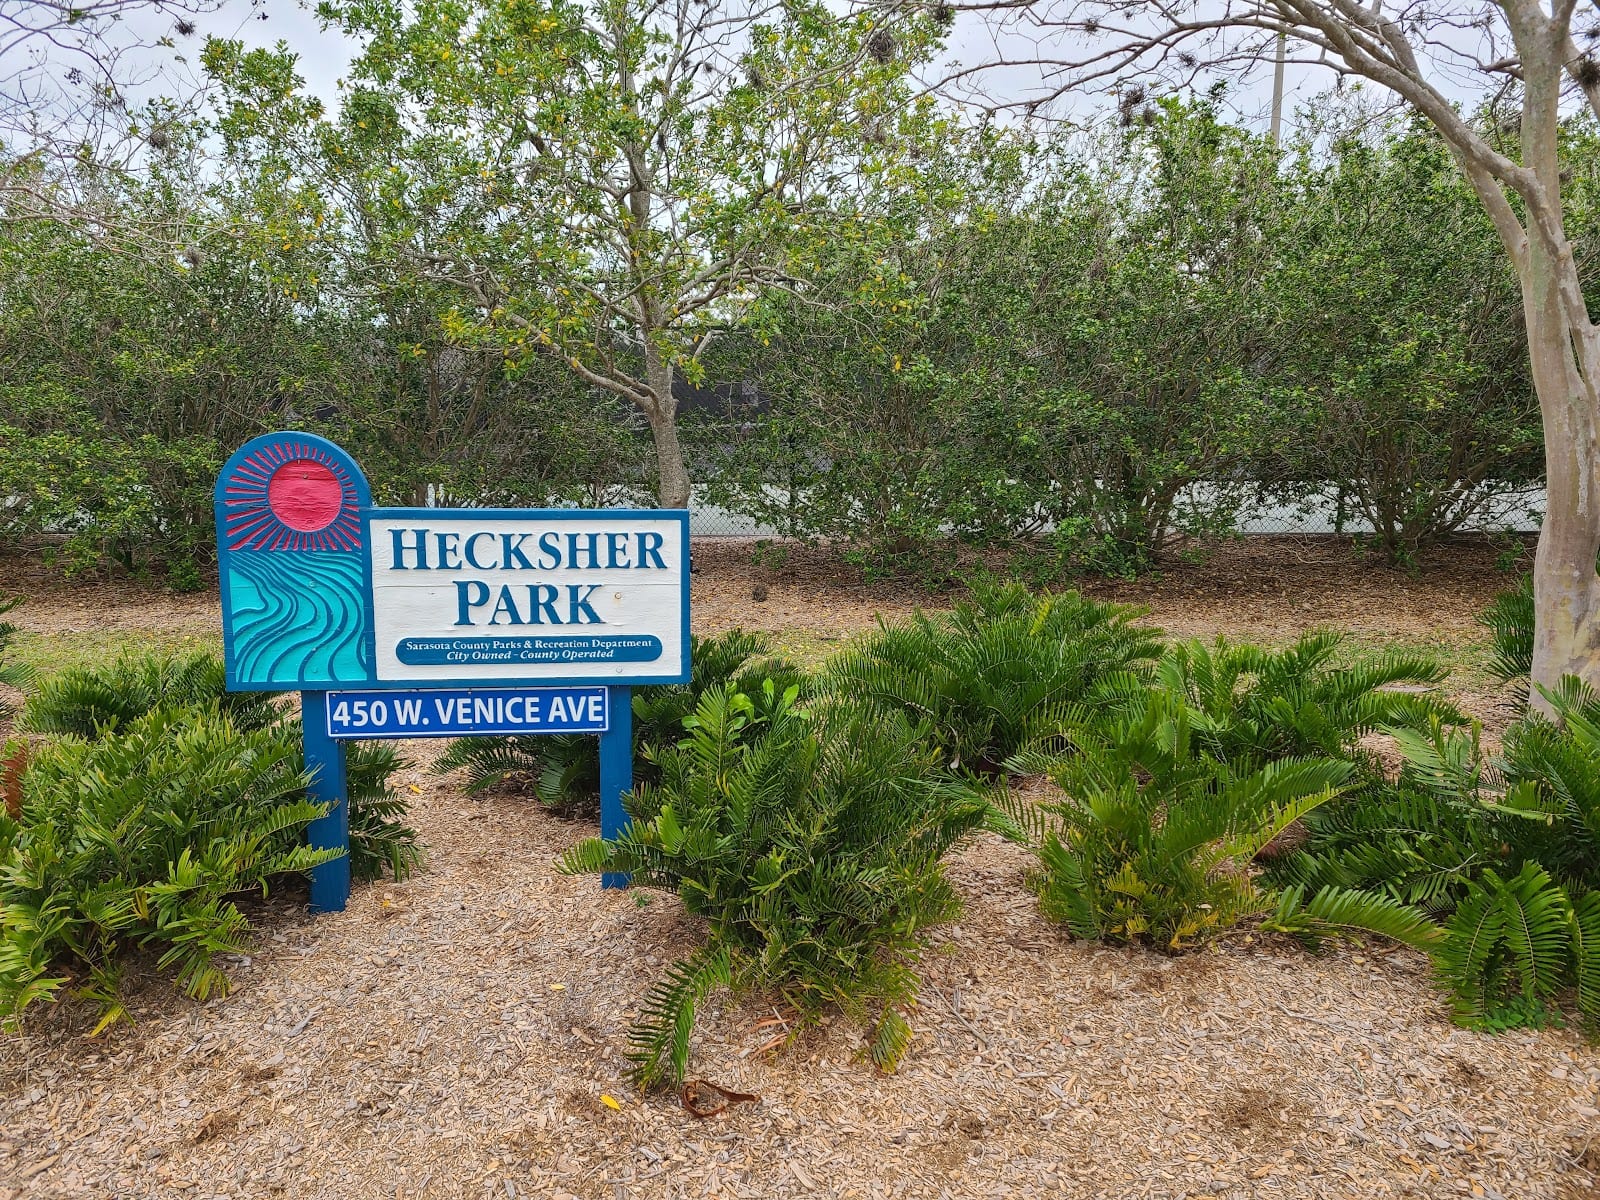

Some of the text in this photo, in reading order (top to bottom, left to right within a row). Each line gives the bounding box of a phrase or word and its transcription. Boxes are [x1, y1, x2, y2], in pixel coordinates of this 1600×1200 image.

[388, 528, 668, 570] HECKSHER
[452, 580, 606, 626] PARK
[406, 639, 652, 651] Sarasota County Parks & Recreation Department
[446, 651, 470, 662] City
[472, 650, 511, 660] Owned
[520, 650, 560, 660] County
[562, 649, 614, 660] Operated
[332, 696, 604, 727] 450 W. VENICE AVE
